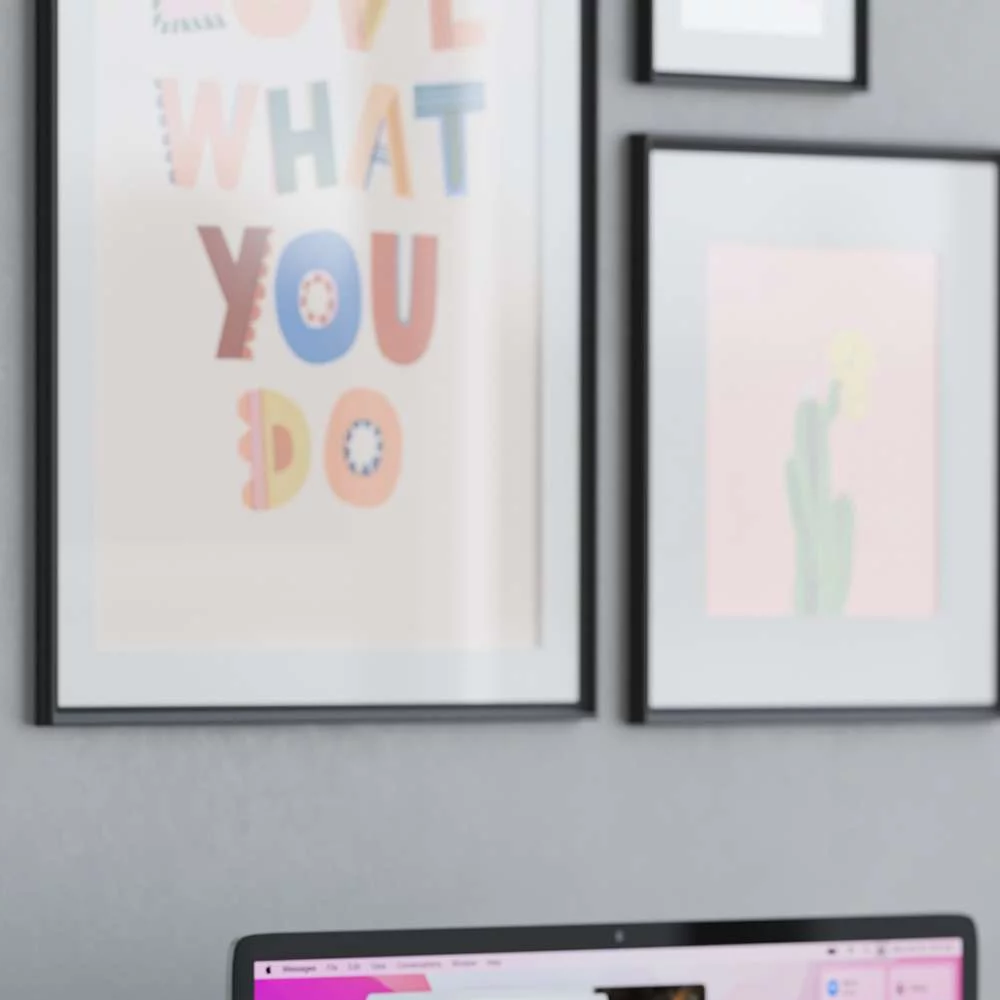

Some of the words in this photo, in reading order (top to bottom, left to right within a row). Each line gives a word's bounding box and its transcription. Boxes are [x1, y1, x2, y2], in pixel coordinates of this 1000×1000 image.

[152, 78, 487, 198] WHAT
[196, 226, 439, 366] YOU
[236, 386, 405, 512] DO
